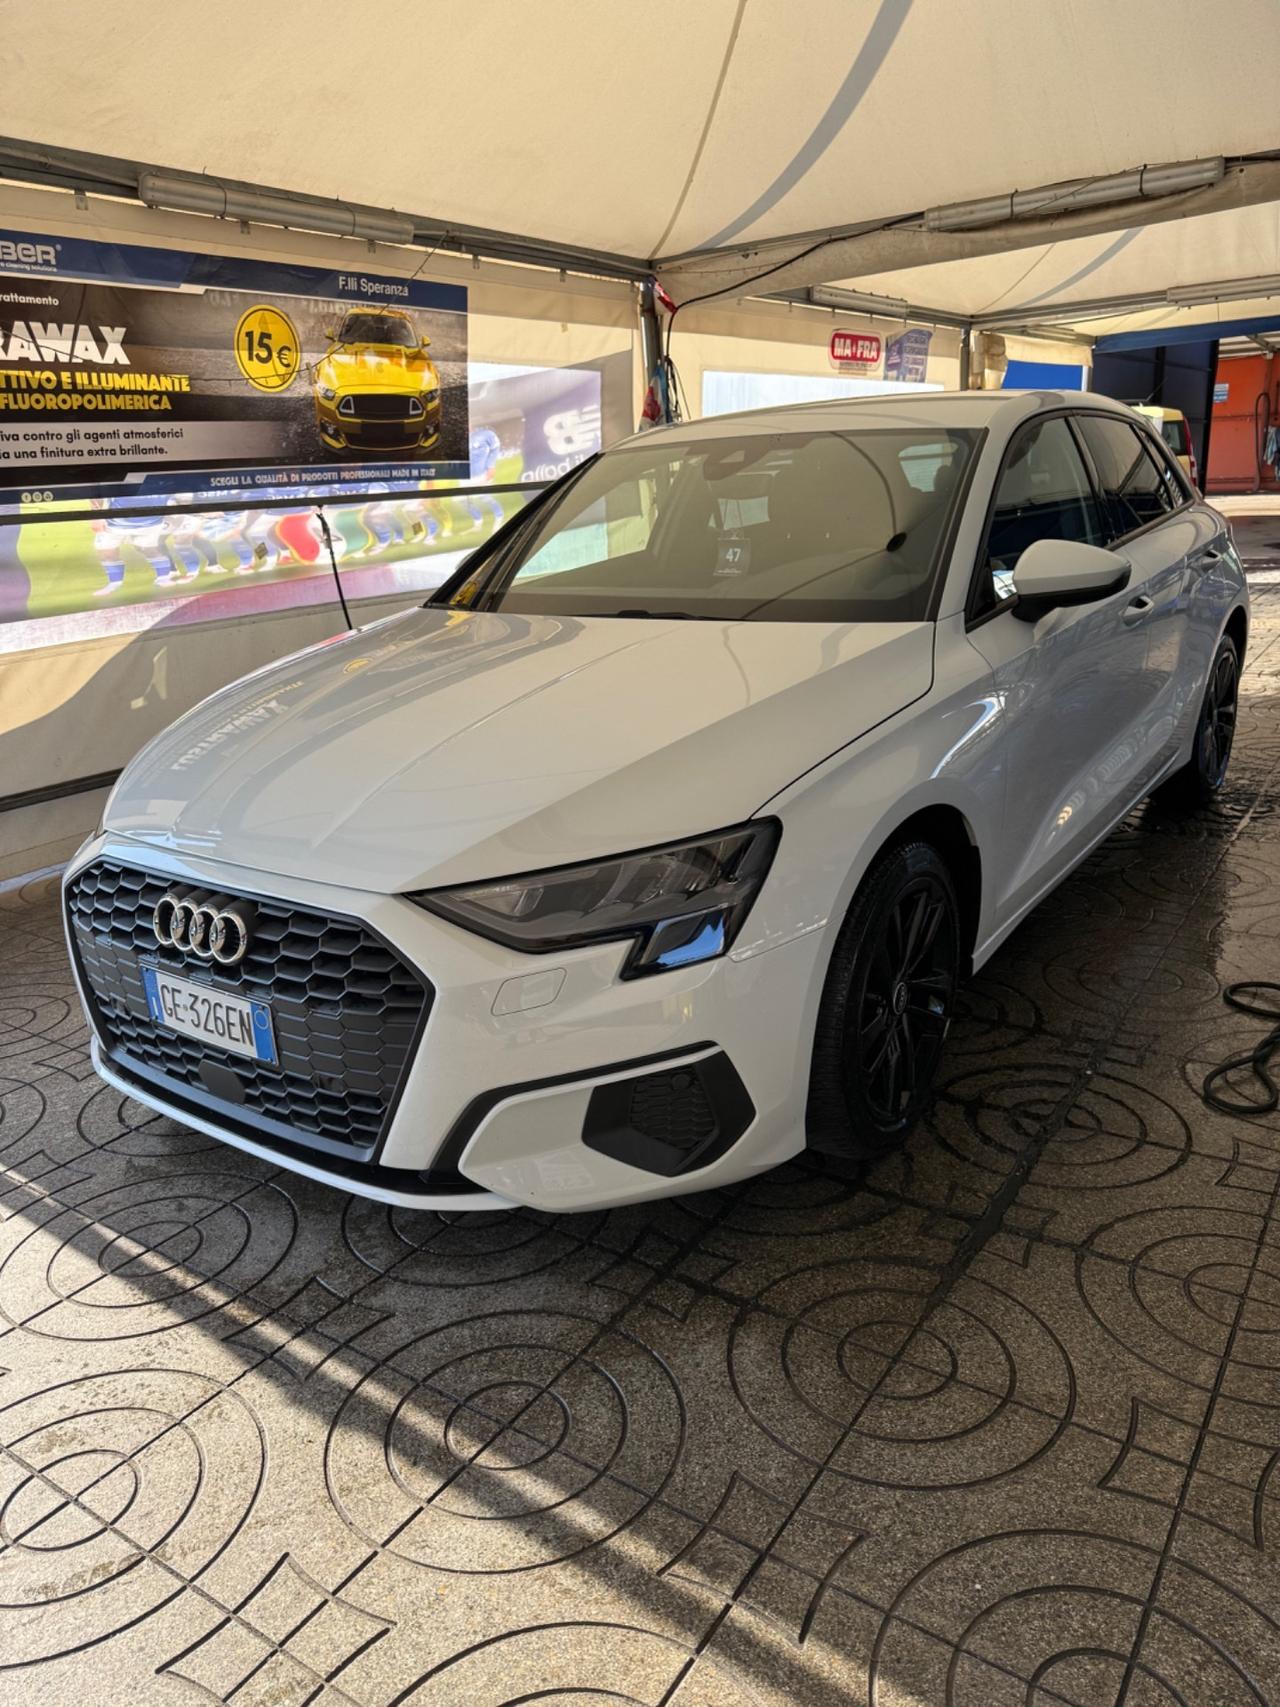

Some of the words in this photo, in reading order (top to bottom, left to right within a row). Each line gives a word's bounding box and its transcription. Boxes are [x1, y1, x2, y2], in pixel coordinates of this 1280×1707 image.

[361, 278, 409, 297] Speranza
[60, 371, 73, 390] E
[75, 371, 191, 392] ILLUMINANTE
[0, 393, 172, 410] FLUOROPOLIMERICA
[23, 430, 63, 441] contro
[66, 429, 80, 444] gli
[84, 429, 120, 442] agenti
[123, 428, 183, 439] atmosferici
[14, 450, 38, 459] una
[40, 446, 84, 458] finitura
[87, 447, 117, 457] extra
[120, 445, 168, 456] brillante.
[210, 476, 238, 486] SCEGLI
[241, 476, 252, 485] LA
[255, 472, 288, 484] QUALITÀ
[291, 473, 299, 482] DI
[302, 471, 338, 482] PRODOTTI
[340, 469, 390, 480] PROFESSIONALI
[392, 469, 410, 477] MADE
[411, 469, 419, 477] IN
[420, 468, 436, 477] ITALY
[726, 548, 741, 562] 47
